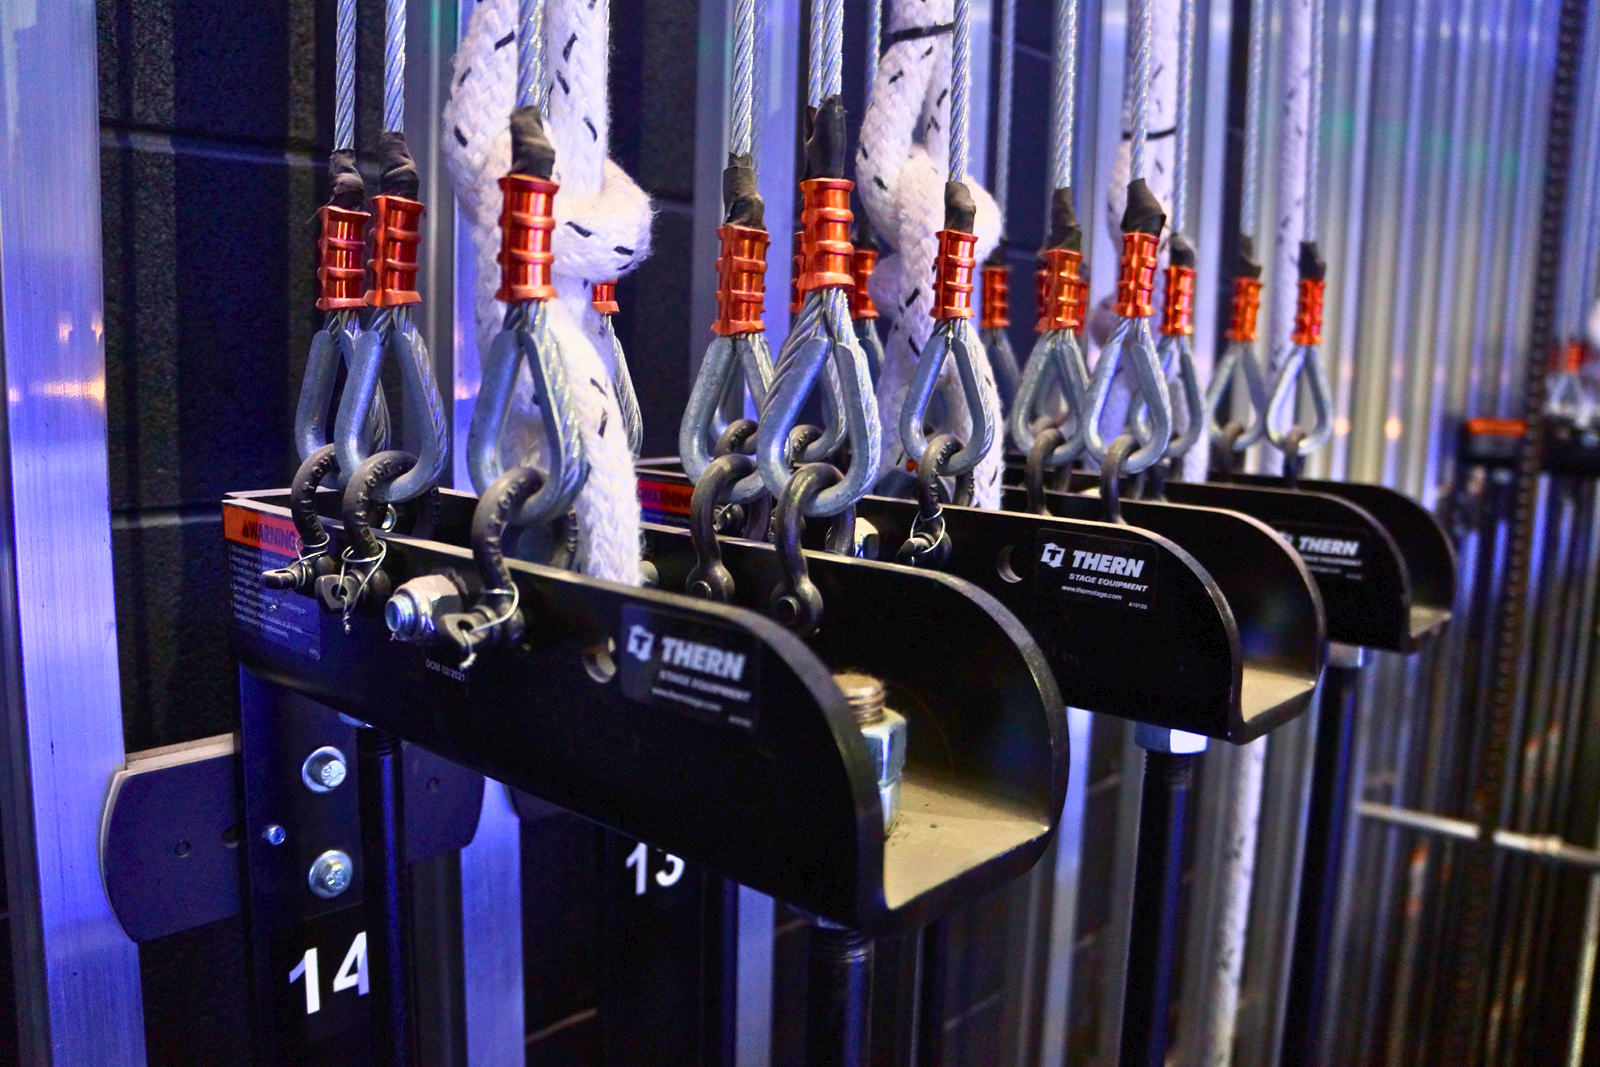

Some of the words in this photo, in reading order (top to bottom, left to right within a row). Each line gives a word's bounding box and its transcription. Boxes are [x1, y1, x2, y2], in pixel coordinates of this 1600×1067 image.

[248, 520, 296, 551] WARNING
[1299, 536, 1359, 556] THERN
[1072, 550, 1144, 578] THERN
[1068, 573, 1098, 584] STAGE
[1098, 578, 1148, 592] EQUIPMENT
[661, 636, 745, 681] THERN
[289, 931, 369, 1014] 14
